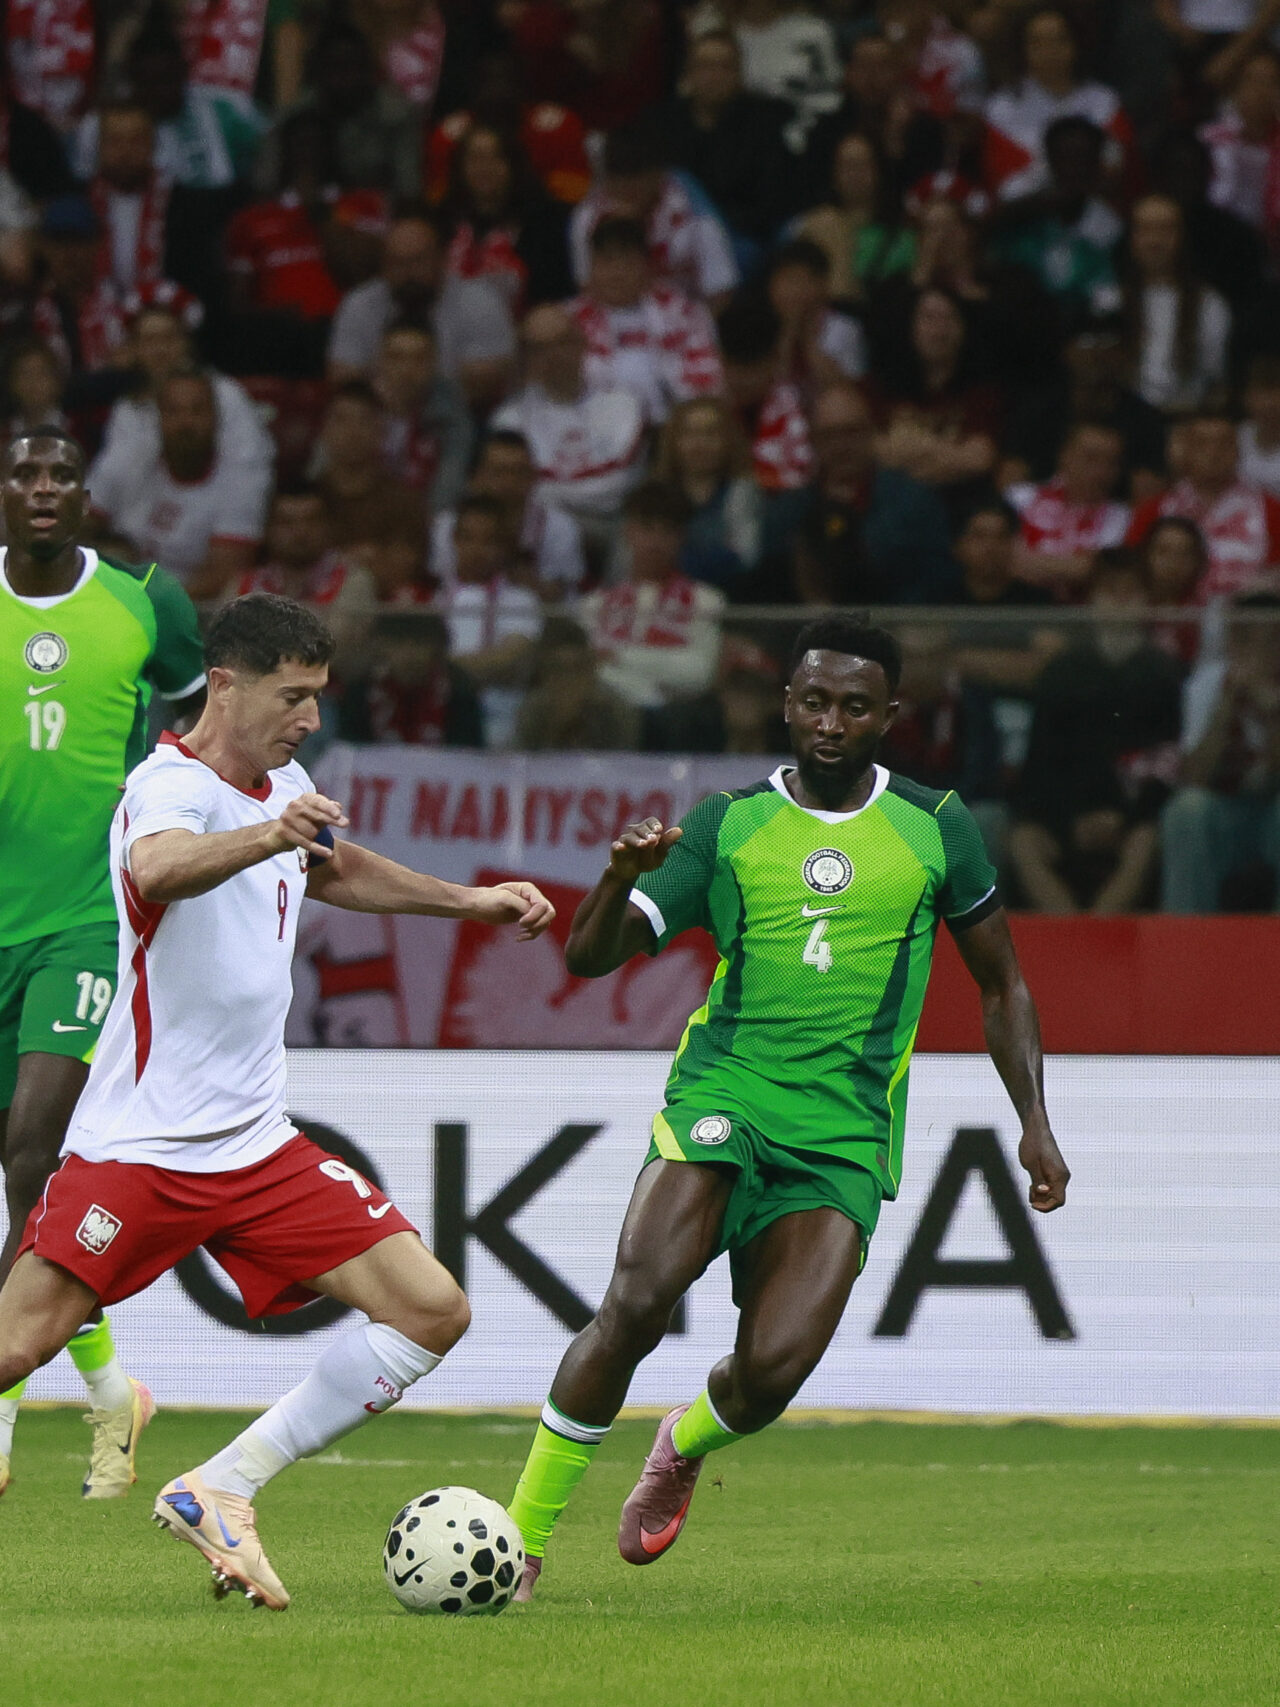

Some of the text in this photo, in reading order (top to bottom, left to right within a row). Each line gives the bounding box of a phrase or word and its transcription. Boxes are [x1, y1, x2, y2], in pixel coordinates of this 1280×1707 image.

[24, 701, 66, 750] 19
[277, 879, 288, 942] 9
[803, 919, 833, 973] 4
[75, 971, 113, 1025] 19
[318, 1159, 372, 1199] 9
